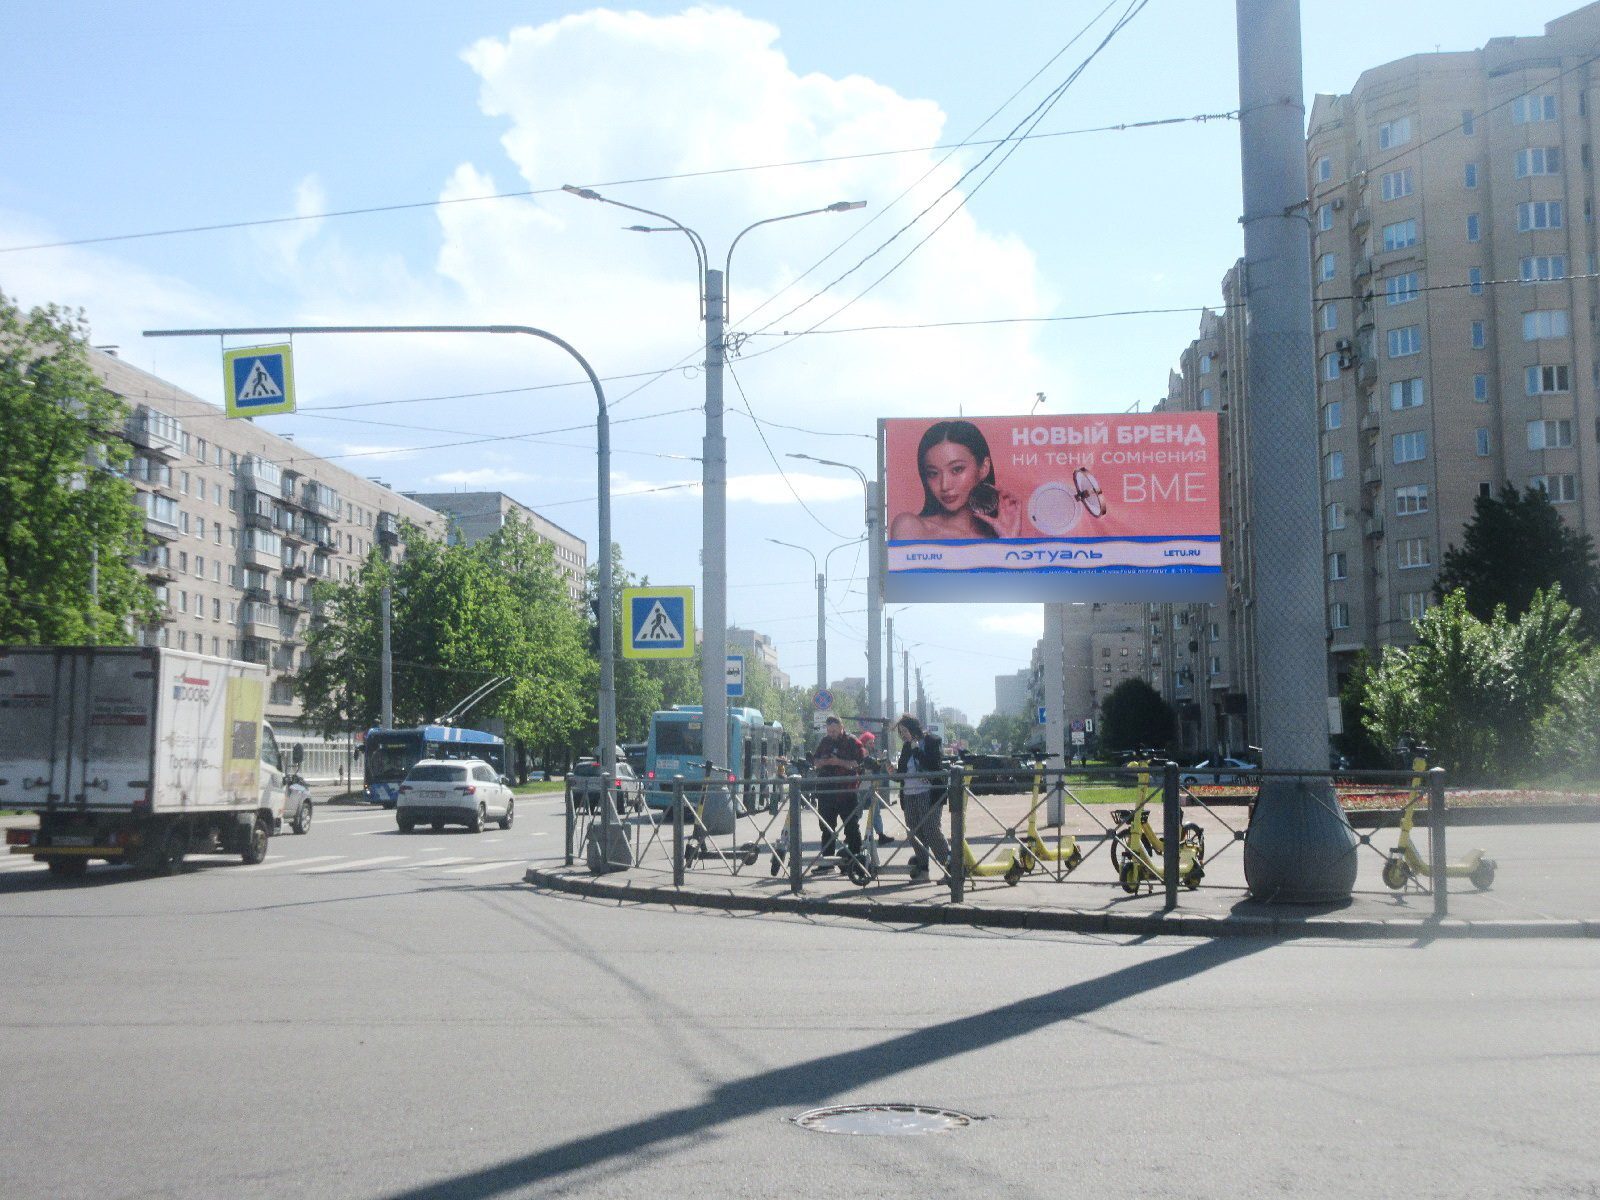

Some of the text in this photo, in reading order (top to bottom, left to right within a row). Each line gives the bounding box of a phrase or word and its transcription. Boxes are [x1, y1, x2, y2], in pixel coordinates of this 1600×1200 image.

[1011, 421, 1206, 446] НОВЫЙ БРЕНД
[906, 553, 943, 561] LETU.RU
[1163, 549, 1201, 557] LETU.RU
